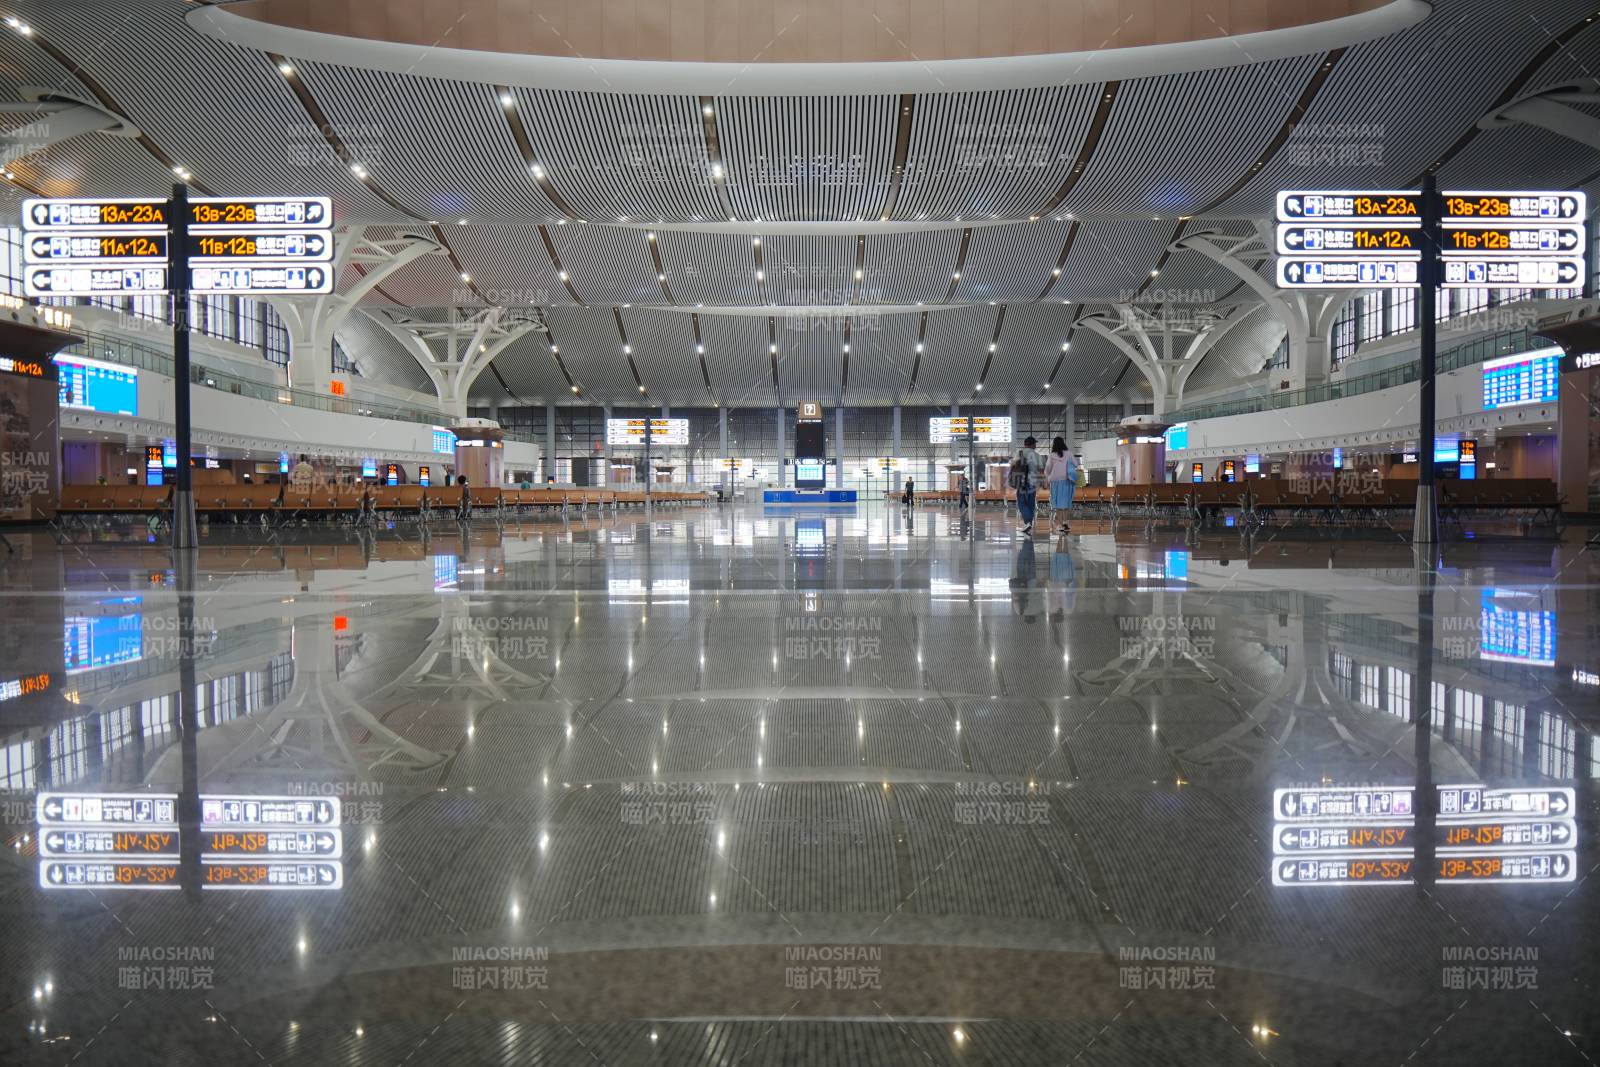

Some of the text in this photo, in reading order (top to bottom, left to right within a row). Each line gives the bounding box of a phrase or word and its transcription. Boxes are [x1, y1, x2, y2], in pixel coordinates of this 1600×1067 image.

[101, 205, 163, 223] 13A-23A
[192, 205, 255, 222] 13B-23B
[1354, 198, 1417, 215] 13A-23A
[1447, 198, 1509, 215] 13B-23B
